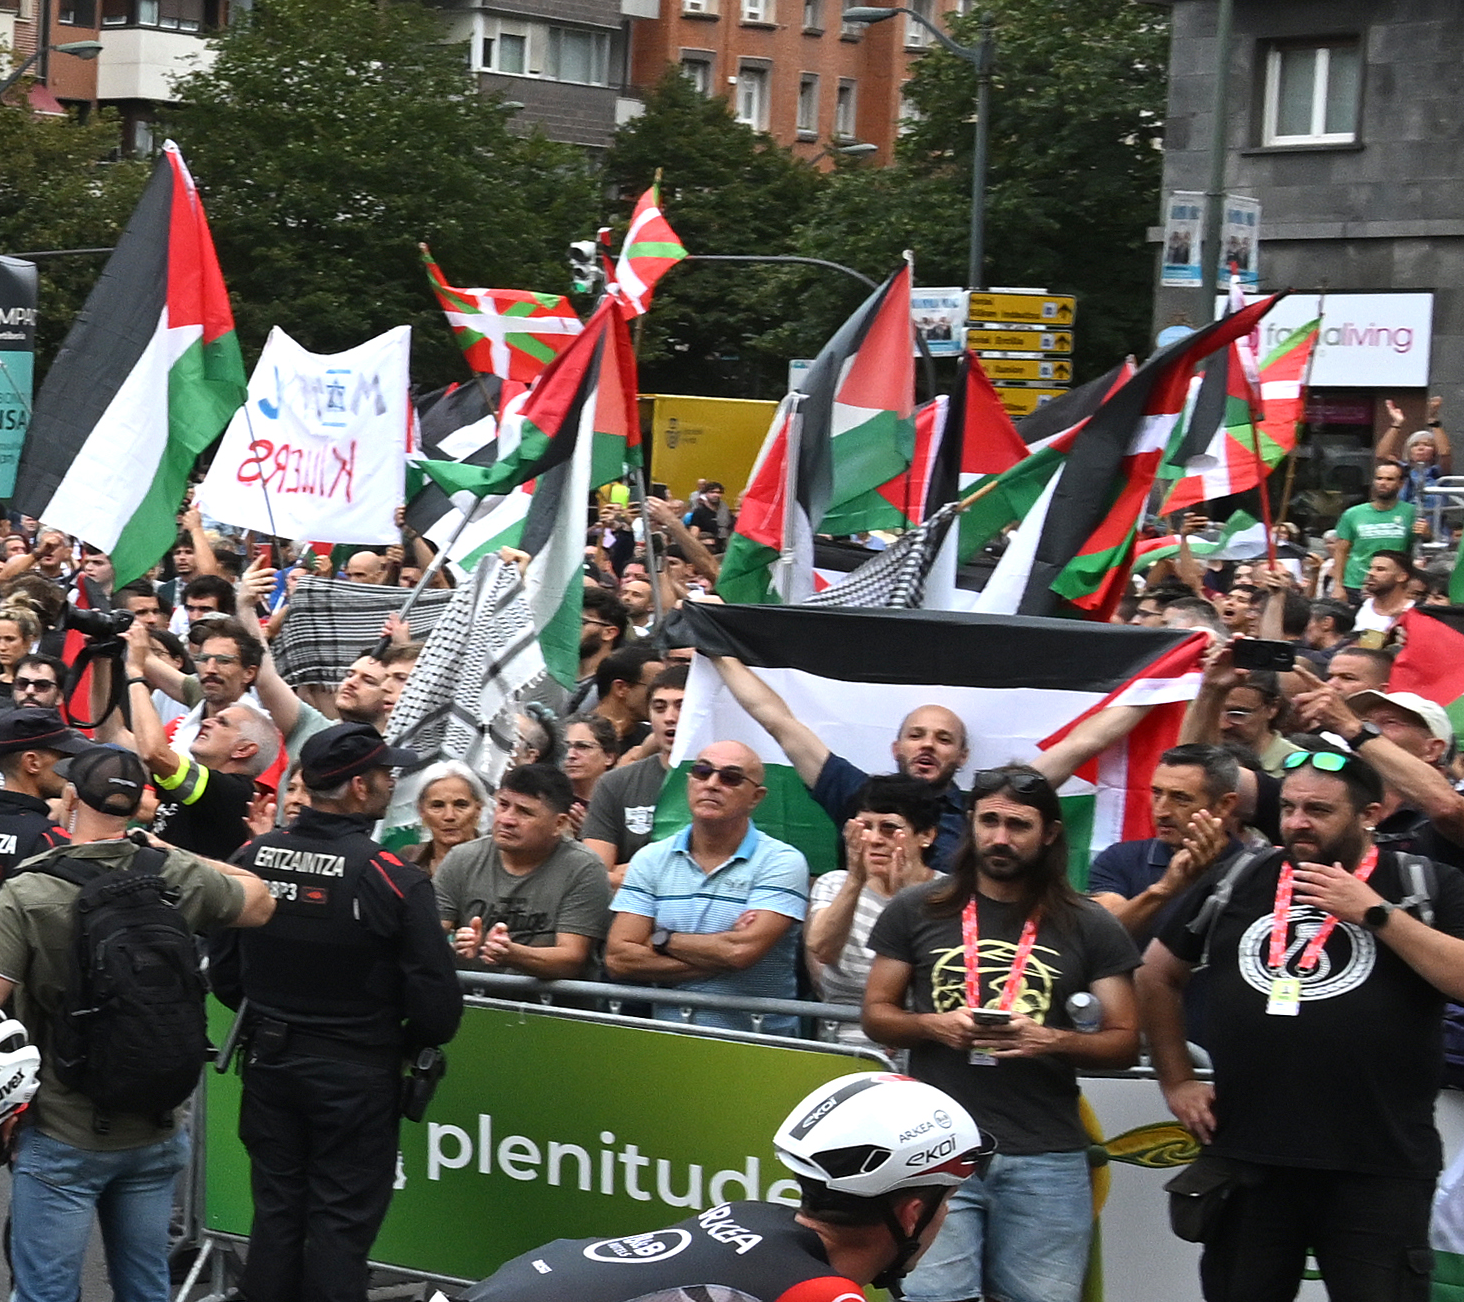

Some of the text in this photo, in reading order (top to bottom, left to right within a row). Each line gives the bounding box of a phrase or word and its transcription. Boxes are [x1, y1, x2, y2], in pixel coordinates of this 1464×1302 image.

[1267, 322, 1414, 353] faaliving
[254, 846, 346, 878] ERTZAINTZA
[898, 1120, 935, 1145] ARKEA
[427, 1112, 805, 1211] plenitude
[623, 1233, 667, 1258] B&B
